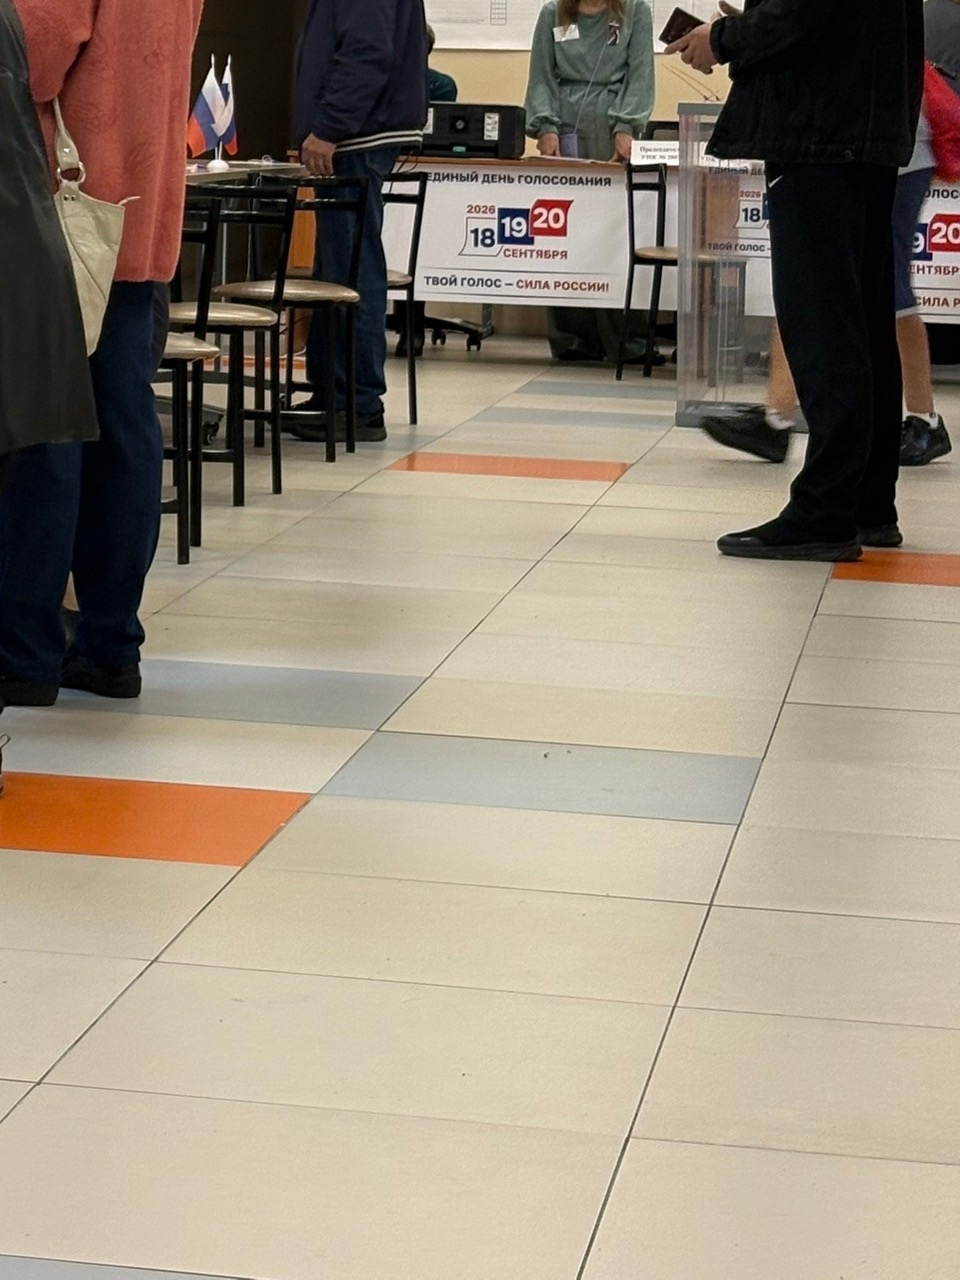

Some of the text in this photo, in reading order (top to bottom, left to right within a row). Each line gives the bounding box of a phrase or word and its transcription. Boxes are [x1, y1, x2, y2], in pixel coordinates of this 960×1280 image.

[427, 171, 612, 187] ЕДИНЫЙ ДЕНЬ ГОЛОСОВАНИЯ
[466, 204, 496, 215] 2026
[741, 207, 761, 223] 18
[470, 207, 565, 248] 18 19 20
[734, 243, 766, 252] ГОЛОС
[503, 248, 568, 261] СЕНТЯБРЯ
[910, 264, 960, 276] ЕНТЯБР
[424, 274, 457, 287] ТВОЙ
[460, 277, 502, 288] ГОЛОС
[516, 279, 551, 290] СИЛА
[553, 281, 610, 293] РОССИИ!
[915, 296, 950, 308] СИЛА
